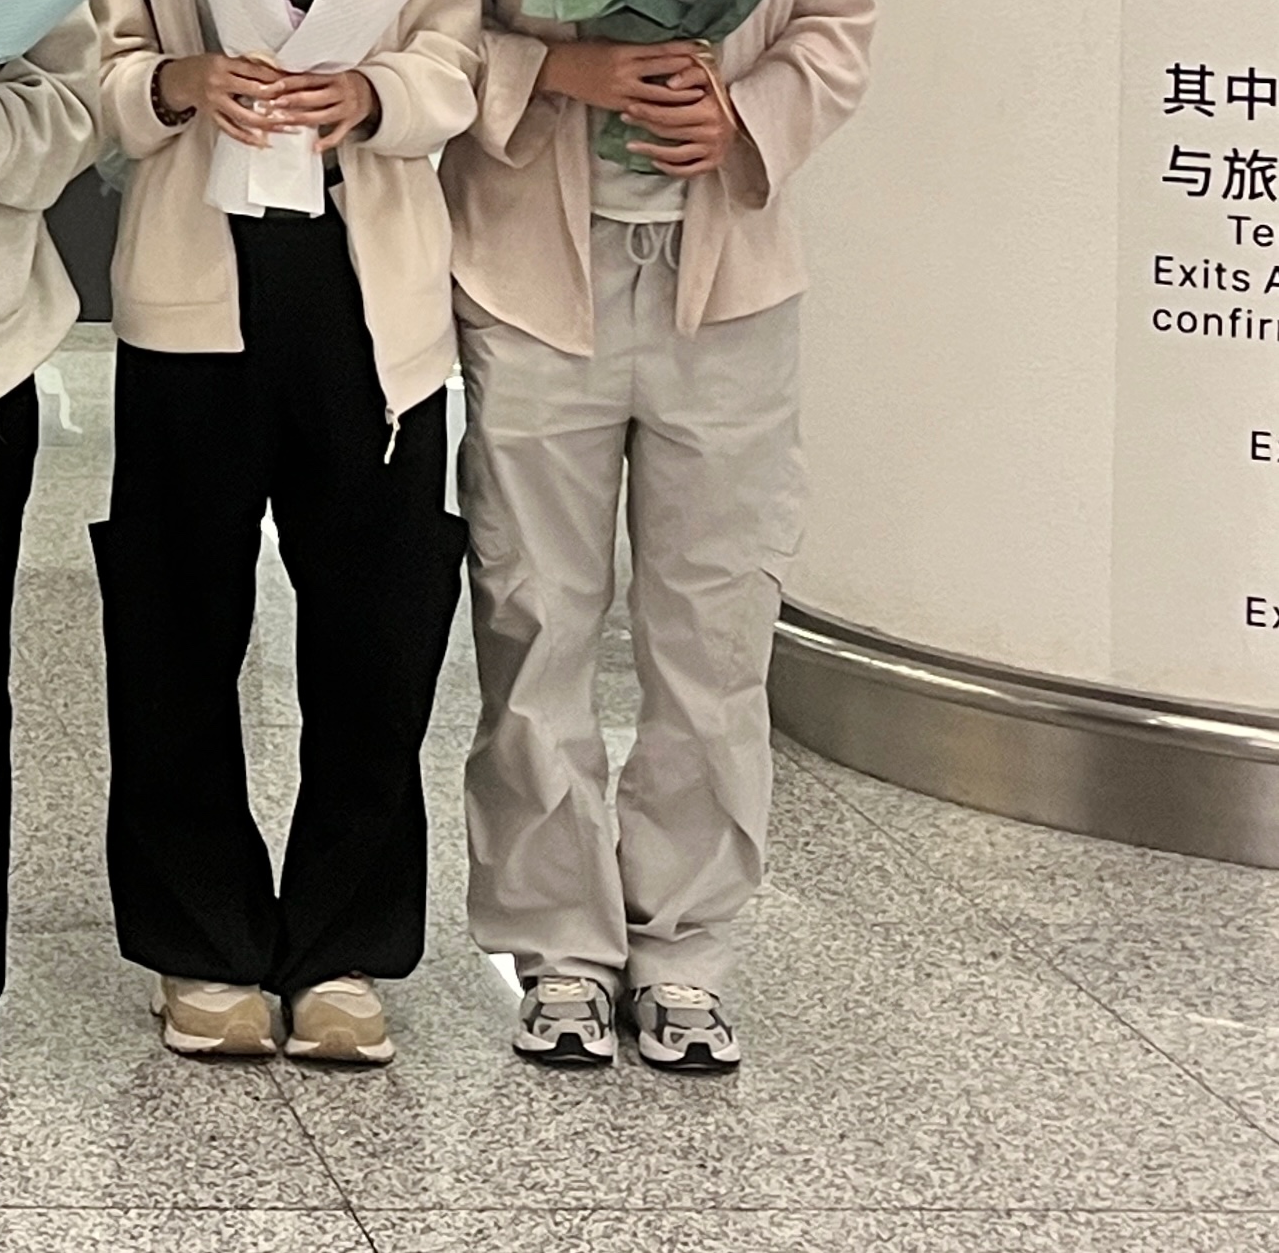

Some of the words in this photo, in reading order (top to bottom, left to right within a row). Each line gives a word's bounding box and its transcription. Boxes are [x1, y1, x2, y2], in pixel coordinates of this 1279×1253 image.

[1162, 61, 1279, 122] 其中
[1161, 143, 1279, 203] 与旅
[1153, 254, 1251, 293] Exits
[1151, 306, 1279, 343] confir
